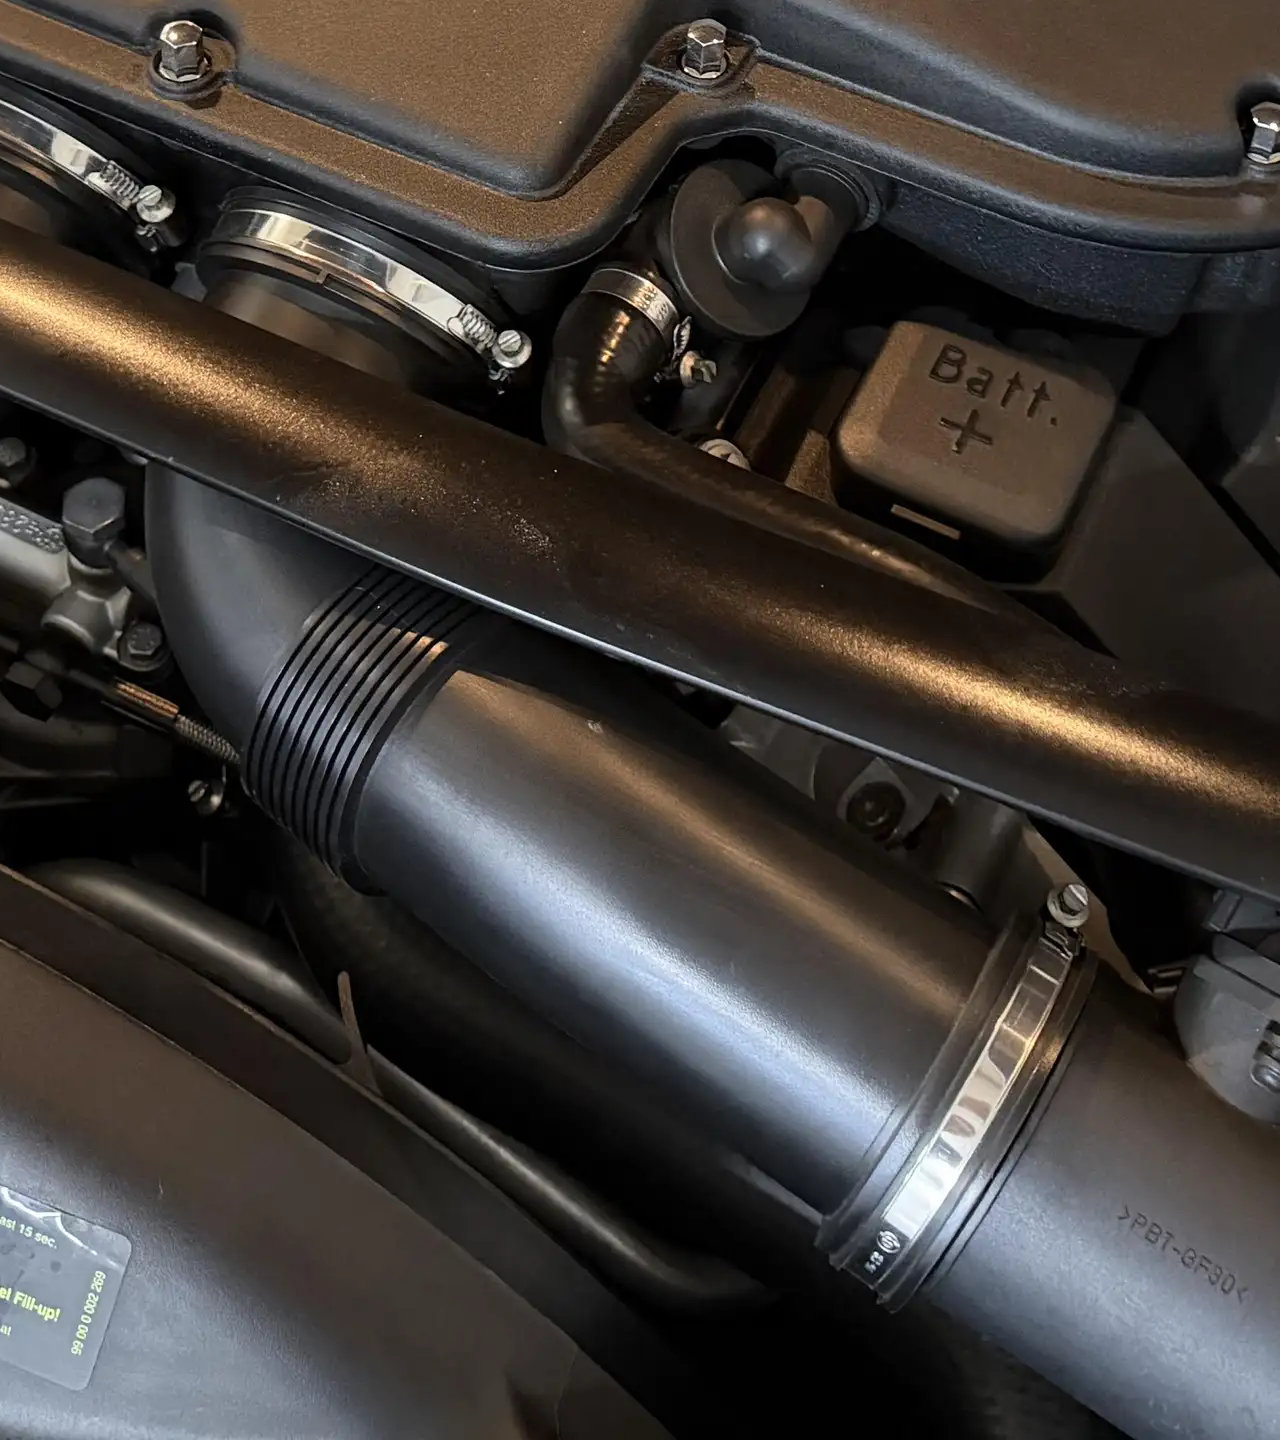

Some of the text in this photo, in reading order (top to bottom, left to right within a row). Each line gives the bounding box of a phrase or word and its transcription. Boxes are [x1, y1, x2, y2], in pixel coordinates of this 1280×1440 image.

[929, 343, 1057, 427] Batt.
[20, 1224, 33, 1238] 15
[34, 1233, 57, 1249] sec.
[14, 1291, 61, 1322] Fill-up!
[71, 1270, 107, 1356] 99 00 0 002 269
[0, 1322, 11, 1337] at
